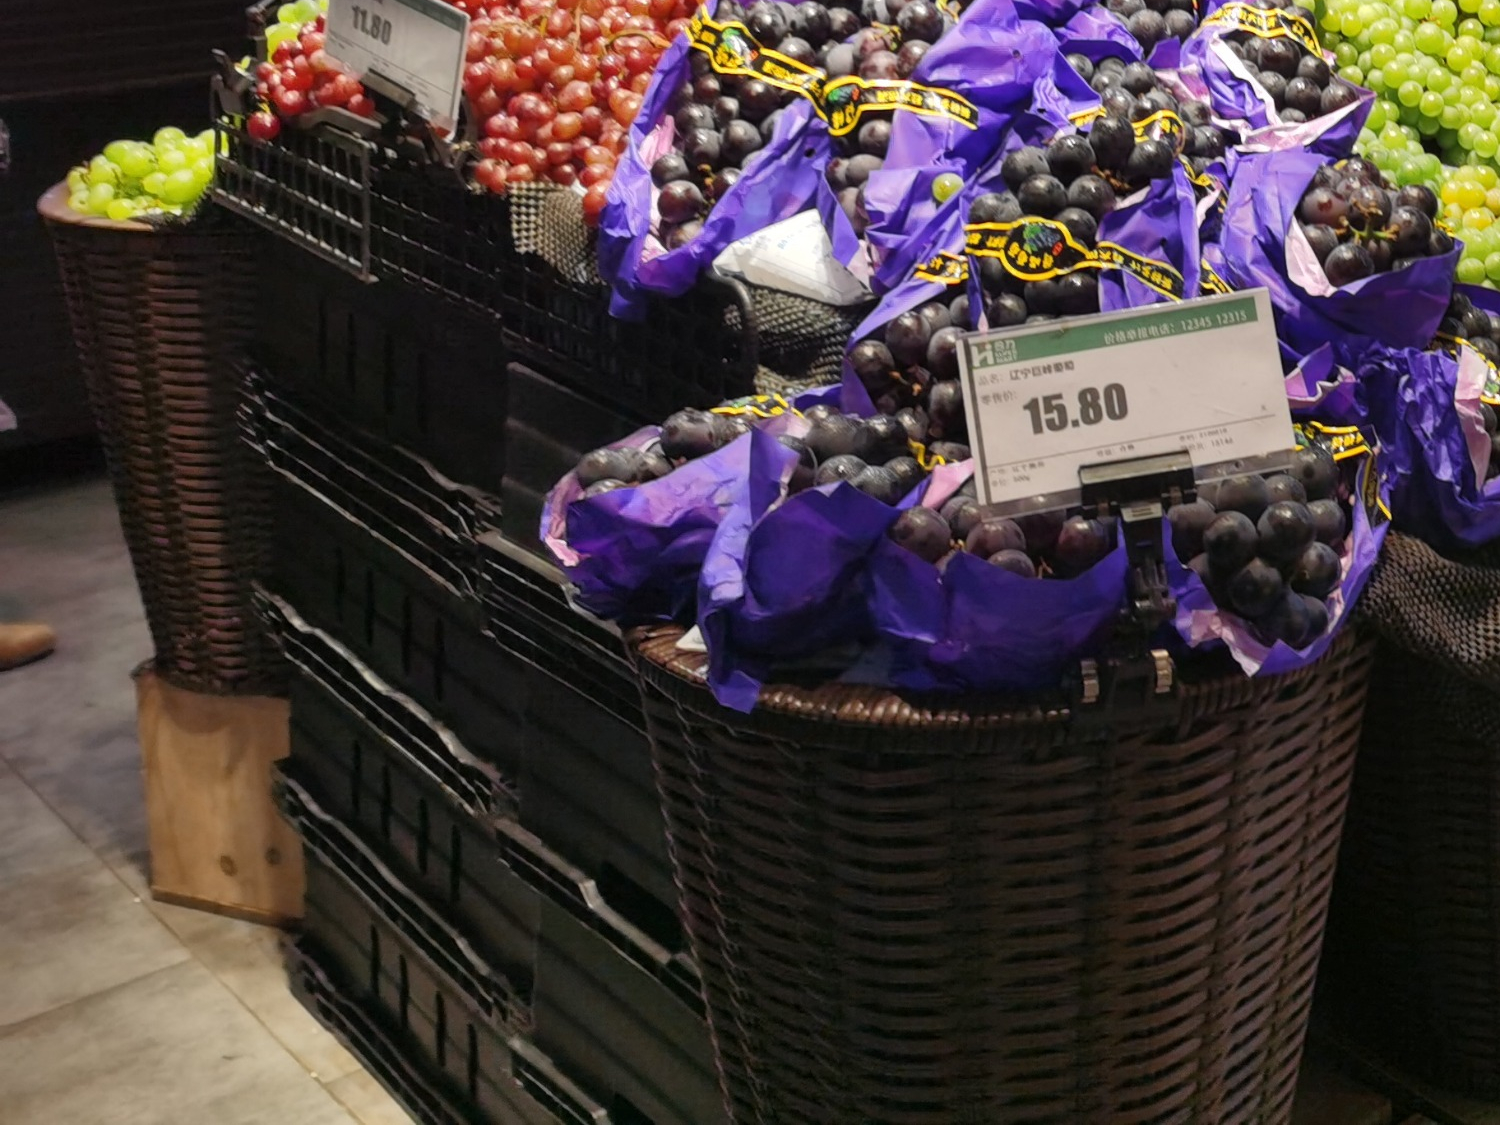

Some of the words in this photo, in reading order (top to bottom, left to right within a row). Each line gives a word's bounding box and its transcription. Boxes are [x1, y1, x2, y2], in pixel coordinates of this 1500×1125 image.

[351, 4, 392, 46] 11.80
[1181, 315, 1212, 331] 12345
[1216, 309, 1248, 325] 12315
[1009, 360, 1075, 381] 辽宁巨峰葡萄
[1023, 382, 1129, 435] 15.80
